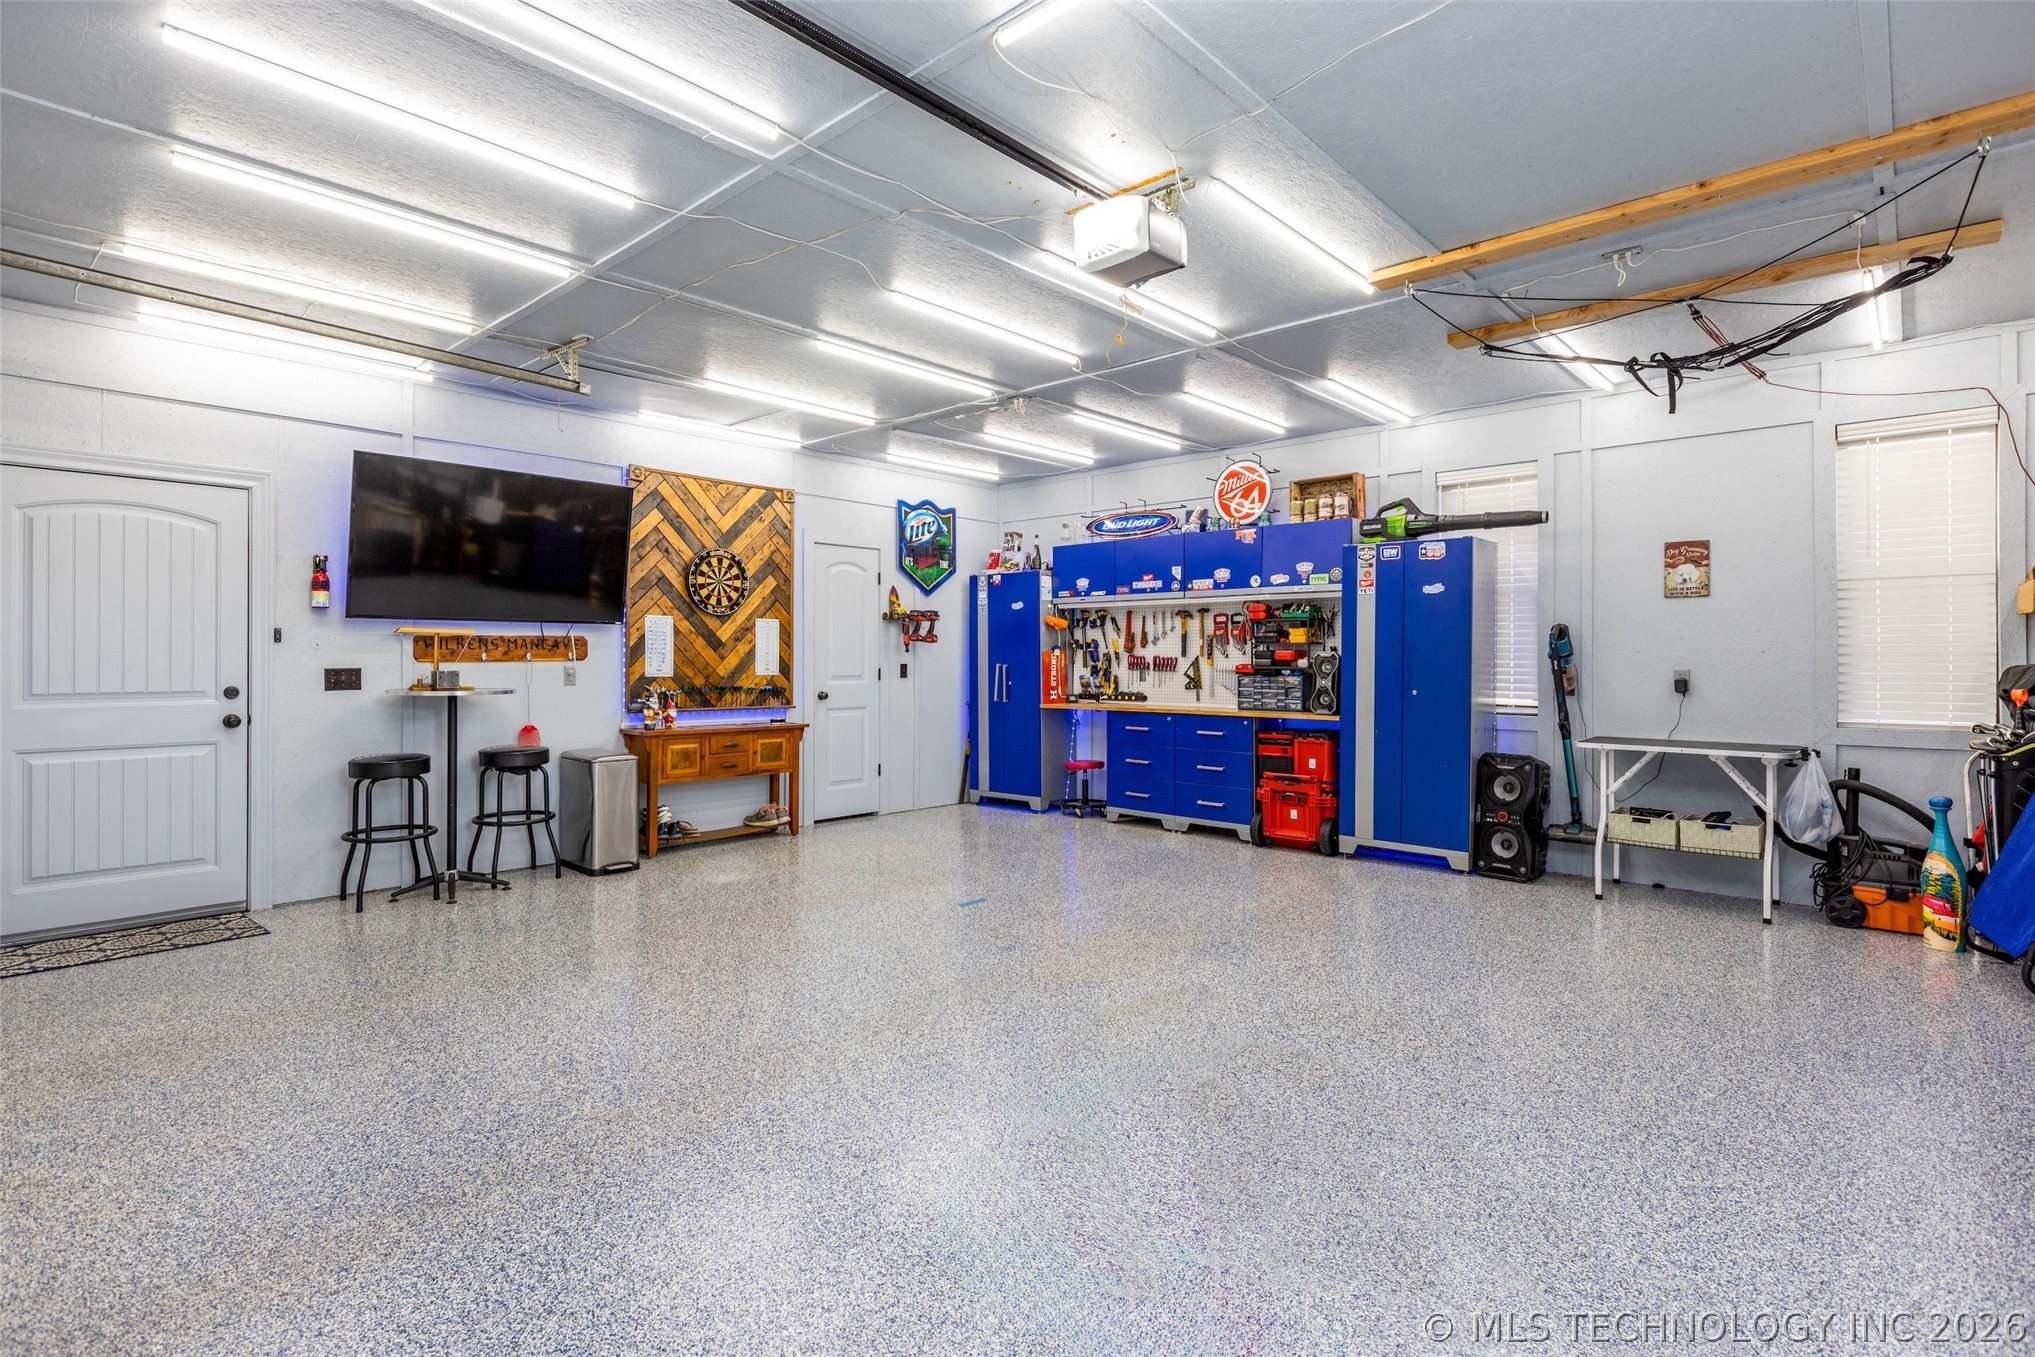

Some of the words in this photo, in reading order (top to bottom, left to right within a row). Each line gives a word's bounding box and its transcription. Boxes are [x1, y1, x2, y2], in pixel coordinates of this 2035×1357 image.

[1231, 486, 1262, 517] 64
[1102, 519, 1126, 531] BUD
[1129, 517, 1161, 528] LIGHT
[1666, 549, 1679, 557] Dog
[507, 637, 581, 651] MANCAVE
